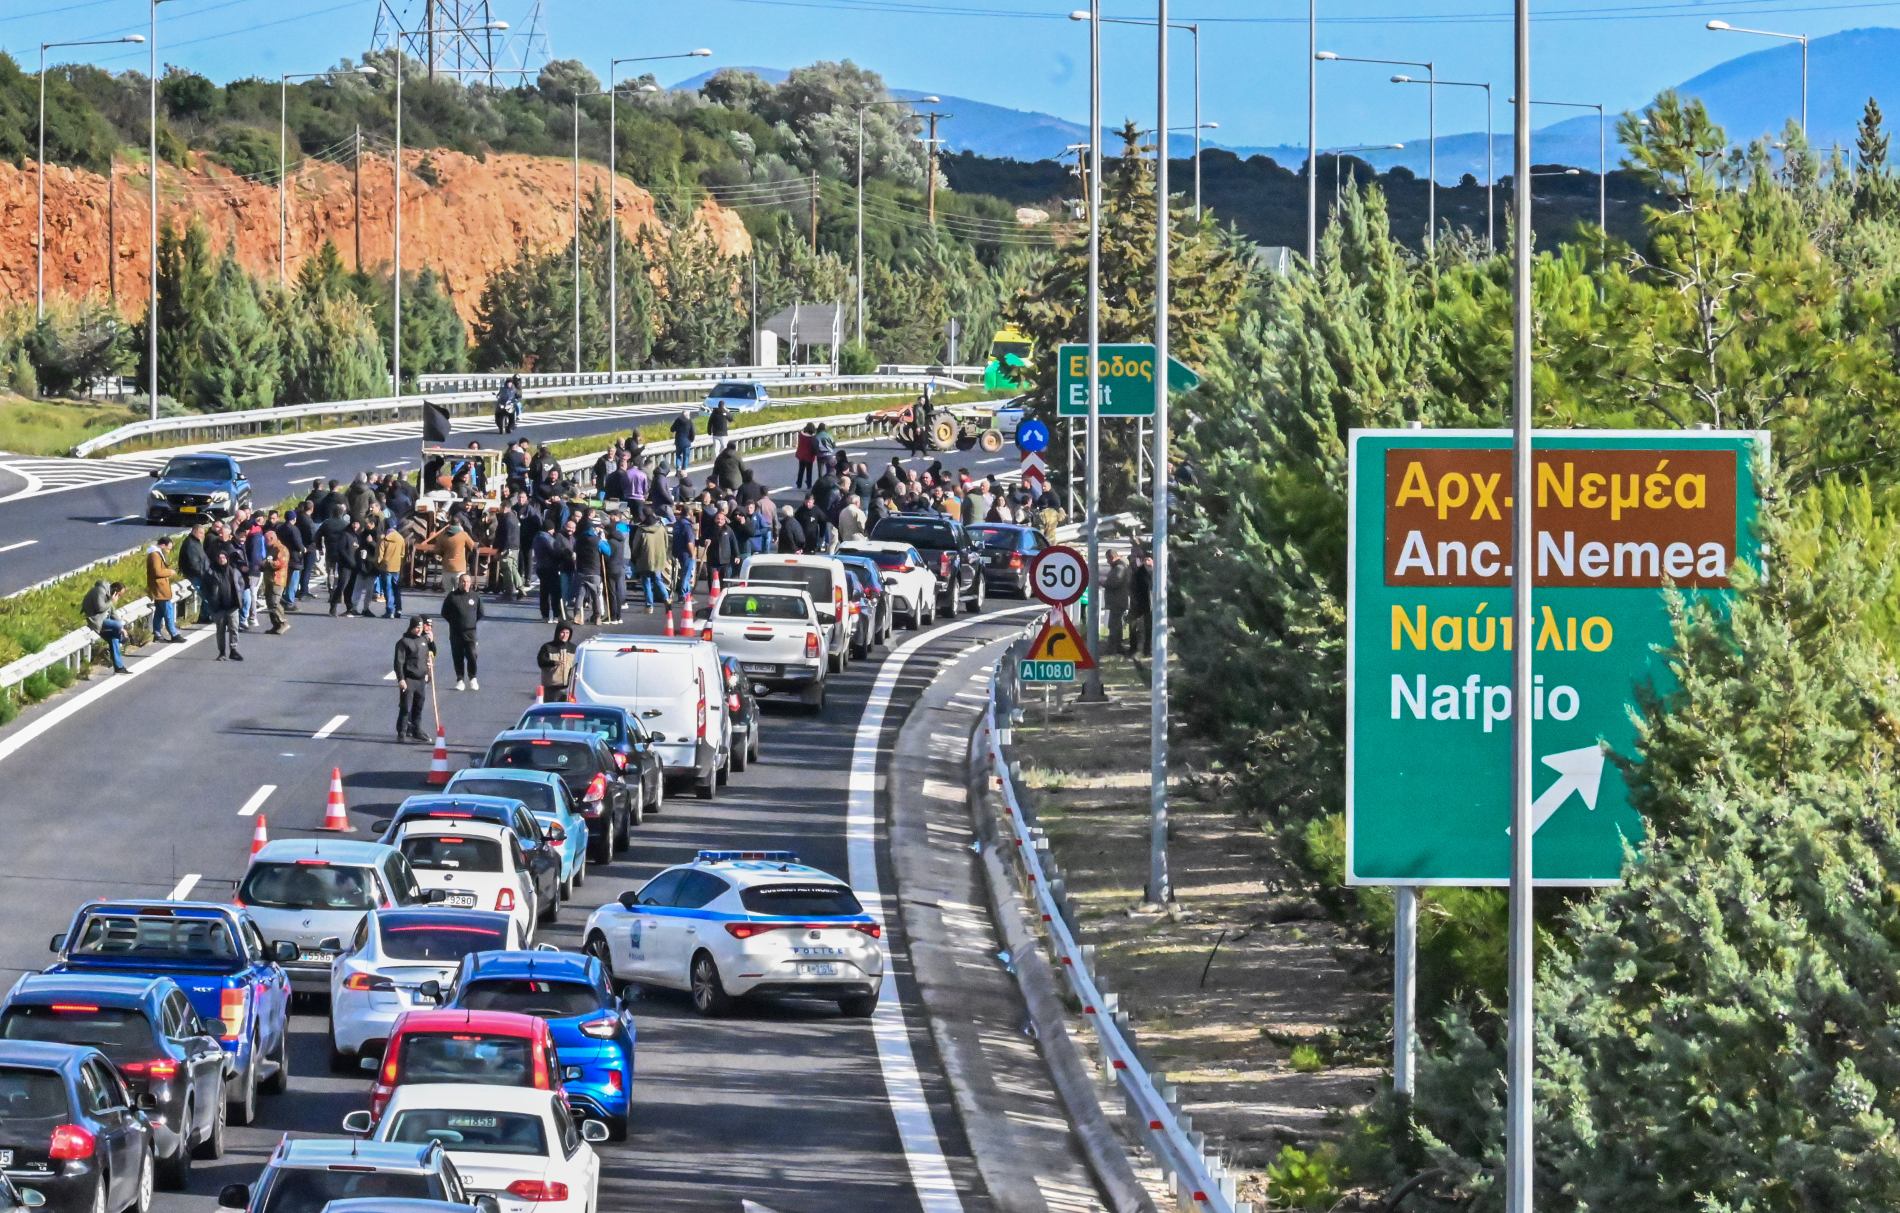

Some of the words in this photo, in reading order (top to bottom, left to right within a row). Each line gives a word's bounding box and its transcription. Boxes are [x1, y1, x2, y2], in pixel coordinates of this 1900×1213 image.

[1395, 461, 1513, 520] Αρχ.
[1537, 459, 1706, 520] Νεμέα
[1042, 564, 1076, 588] 50
[1394, 530, 1513, 577] Anc.
[1537, 531, 1726, 578] Nemea
[1390, 674, 1580, 733] Nafpio
